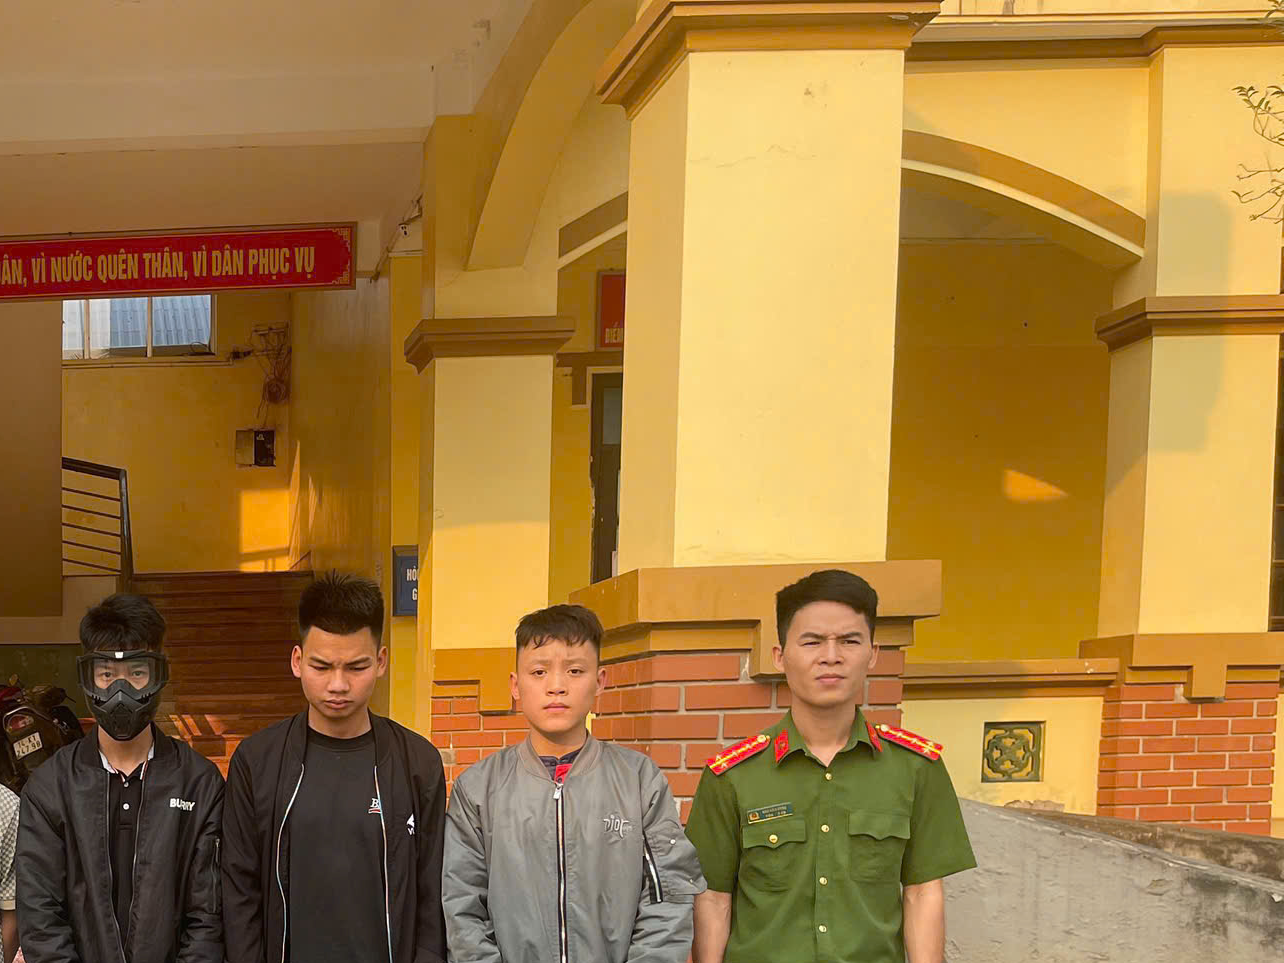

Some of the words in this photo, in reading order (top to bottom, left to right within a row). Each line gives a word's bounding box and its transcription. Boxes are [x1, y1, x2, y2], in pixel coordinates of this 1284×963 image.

[31, 252, 46, 284] VÌ
[50, 250, 93, 283] NƯỚC
[97, 248, 140, 284] QUÊN
[143, 246, 188, 281] THÂN,
[192, 244, 208, 277] VÌ
[211, 243, 244, 277] DÂN
[248, 247, 290, 280] PHỤC
[294, 246, 315, 279] VỤ
